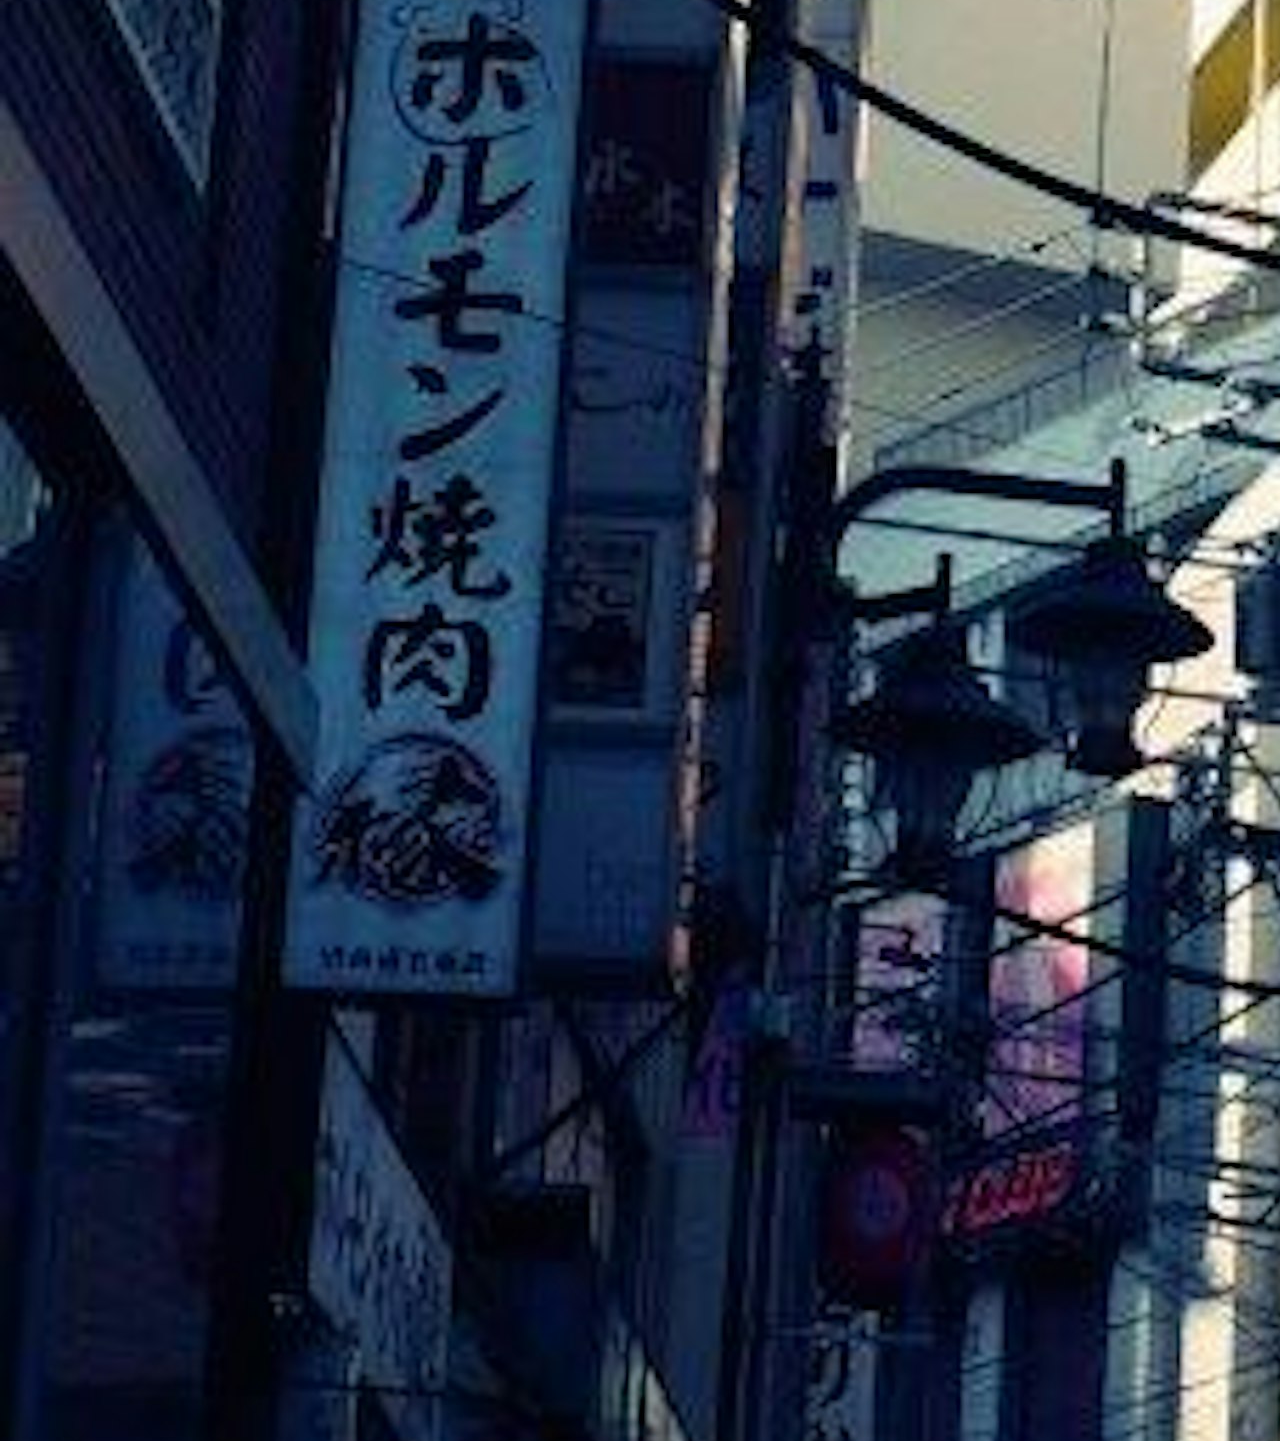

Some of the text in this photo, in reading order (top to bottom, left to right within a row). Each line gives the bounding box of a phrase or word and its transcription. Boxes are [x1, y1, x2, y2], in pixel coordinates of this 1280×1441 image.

[364, 10, 546, 724] ホルモン焼肉
